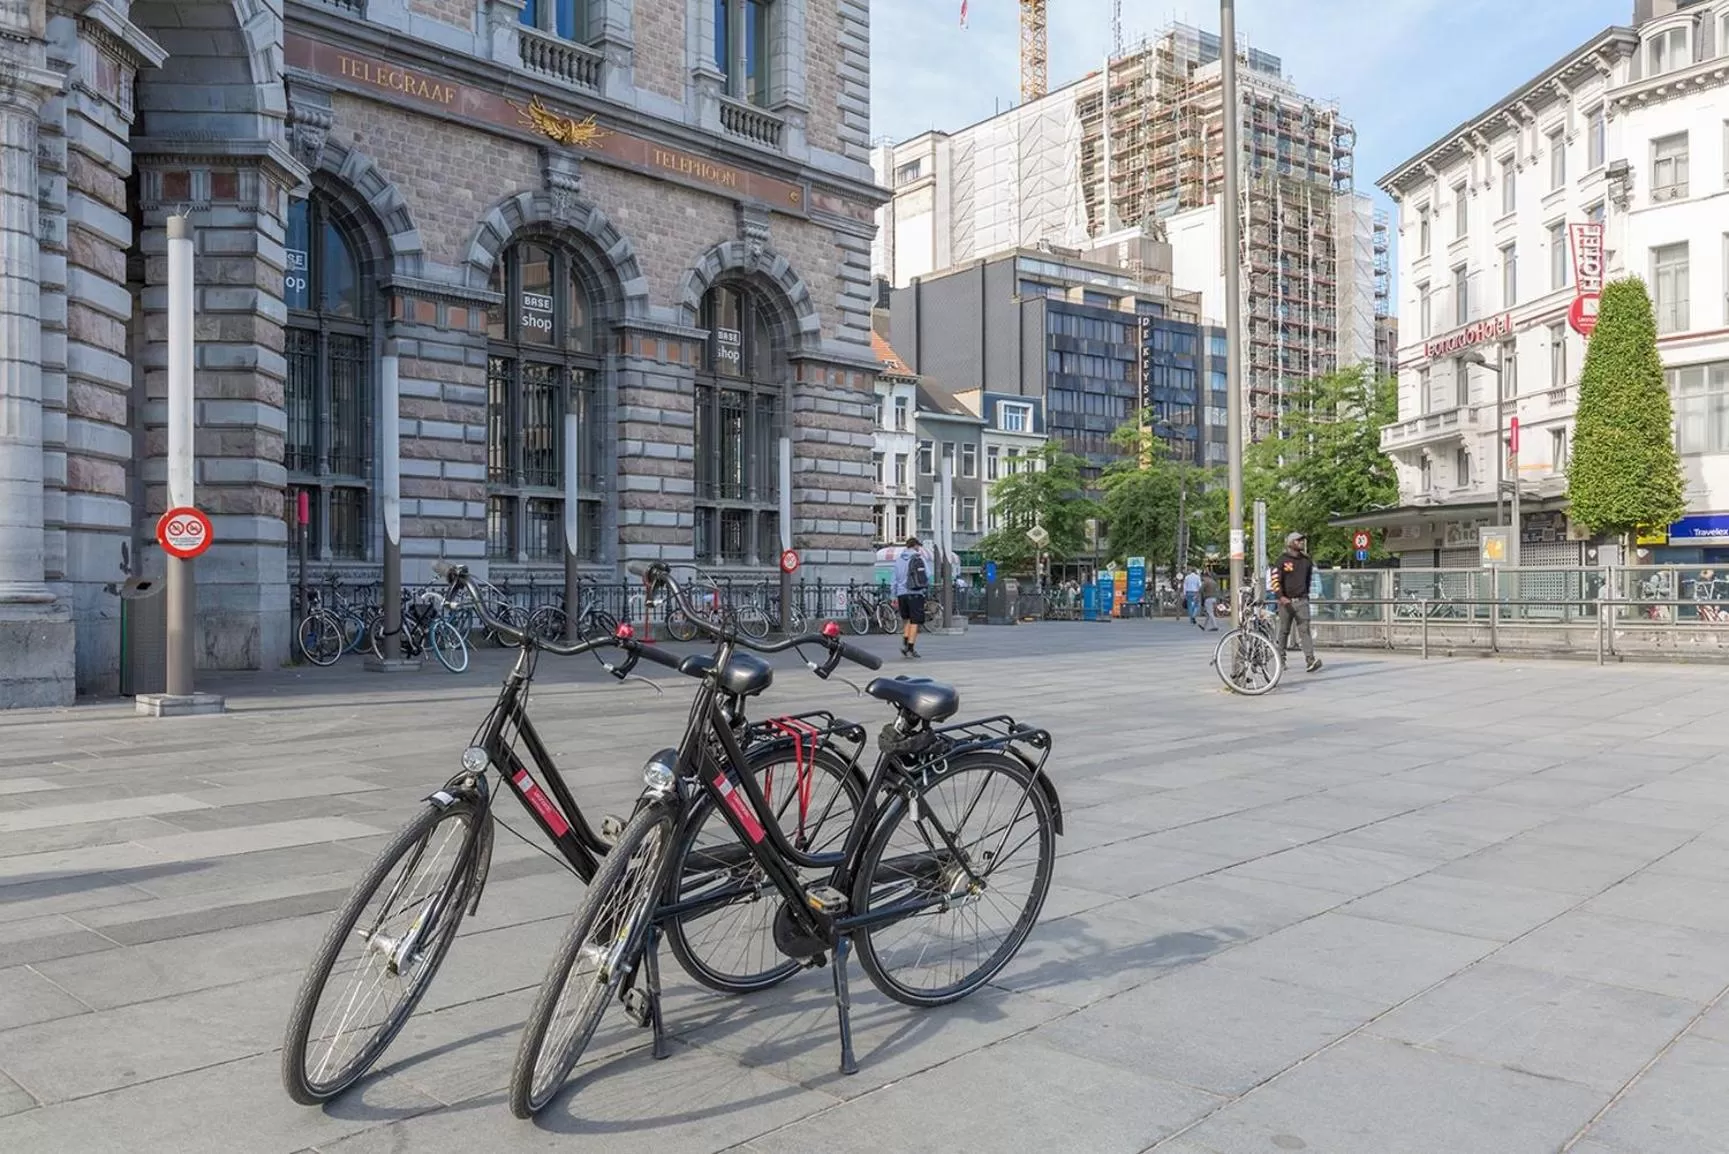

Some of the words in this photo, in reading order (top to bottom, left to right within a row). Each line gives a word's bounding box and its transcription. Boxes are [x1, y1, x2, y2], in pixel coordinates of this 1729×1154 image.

[337, 55, 456, 104] TELEGRAAF
[654, 149, 736, 187] TELEPHOON
[1577, 226, 1601, 292] HOTEL
[521, 312, 552, 333] shop
[524, 295, 550, 309] BASE
[1423, 328, 1477, 358] Leonardo
[1477, 313, 1512, 343] Hotel
